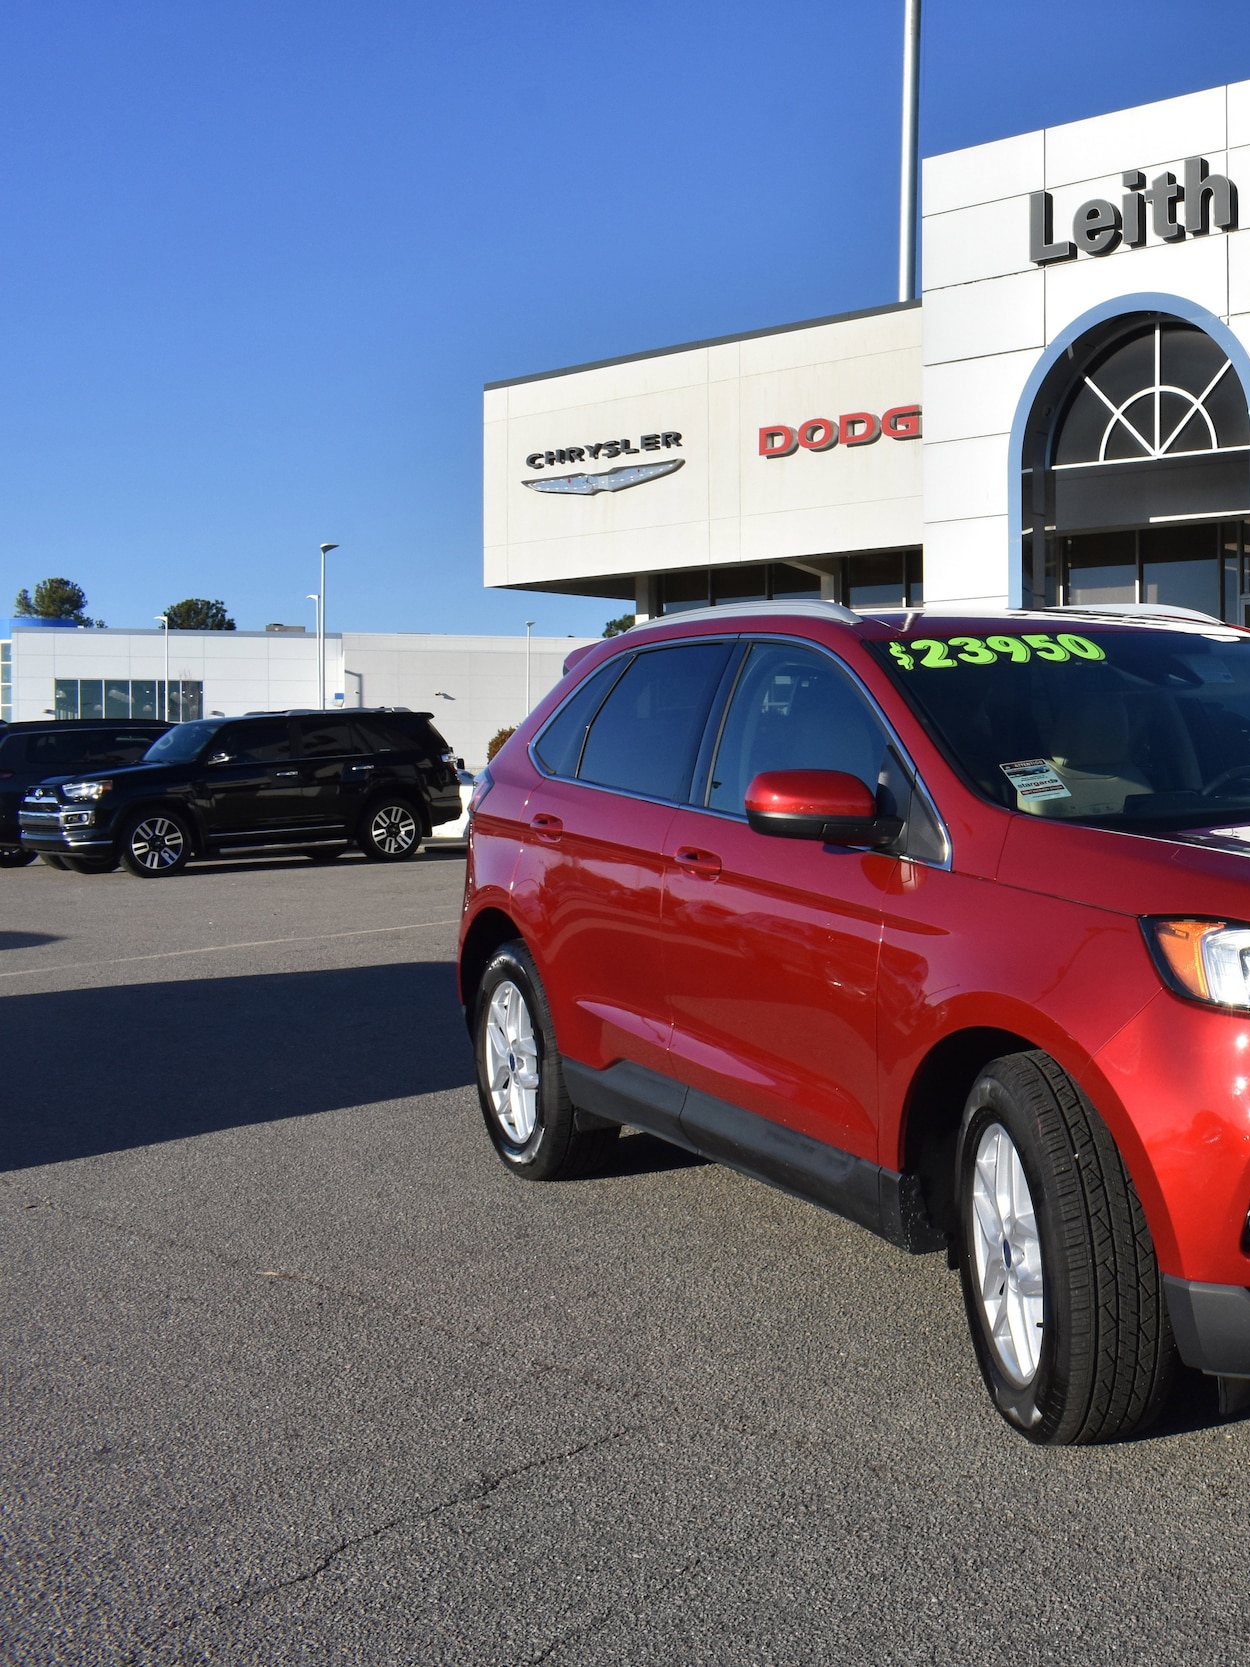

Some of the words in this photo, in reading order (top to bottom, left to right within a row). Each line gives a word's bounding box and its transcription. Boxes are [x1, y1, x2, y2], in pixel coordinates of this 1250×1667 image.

[1029, 156, 1239, 267] Leith
[525, 430, 683, 470] CHRYSLER
[758, 404, 922, 459] DODG
[888, 633, 1107, 671] $23950
